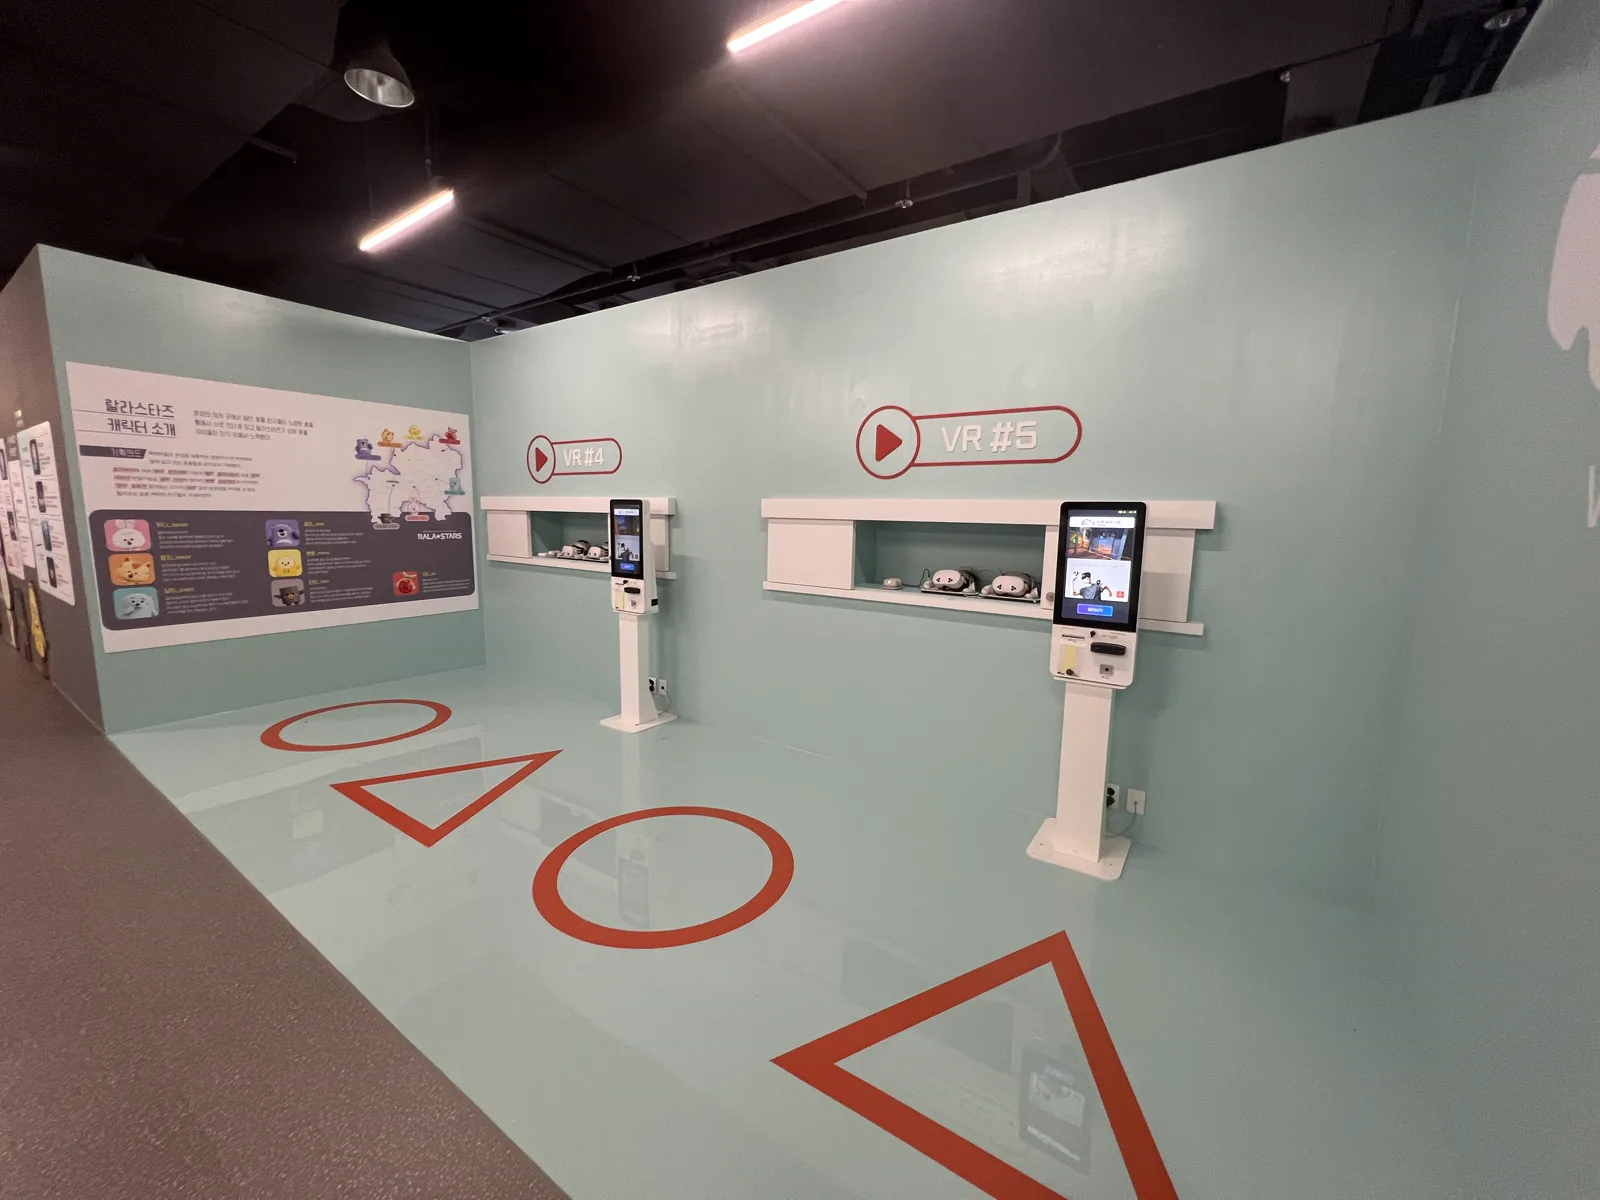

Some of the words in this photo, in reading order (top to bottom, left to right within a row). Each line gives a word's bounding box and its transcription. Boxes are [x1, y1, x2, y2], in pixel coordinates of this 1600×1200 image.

[105, 398, 175, 418] 랄라스타즈
[107, 418, 148, 434] 캐릭터
[151, 422, 177, 436] 소개
[940, 424, 983, 453] VR
[989, 420, 1038, 453] #5
[562, 448, 582, 467] VR
[584, 447, 604, 467] #4
